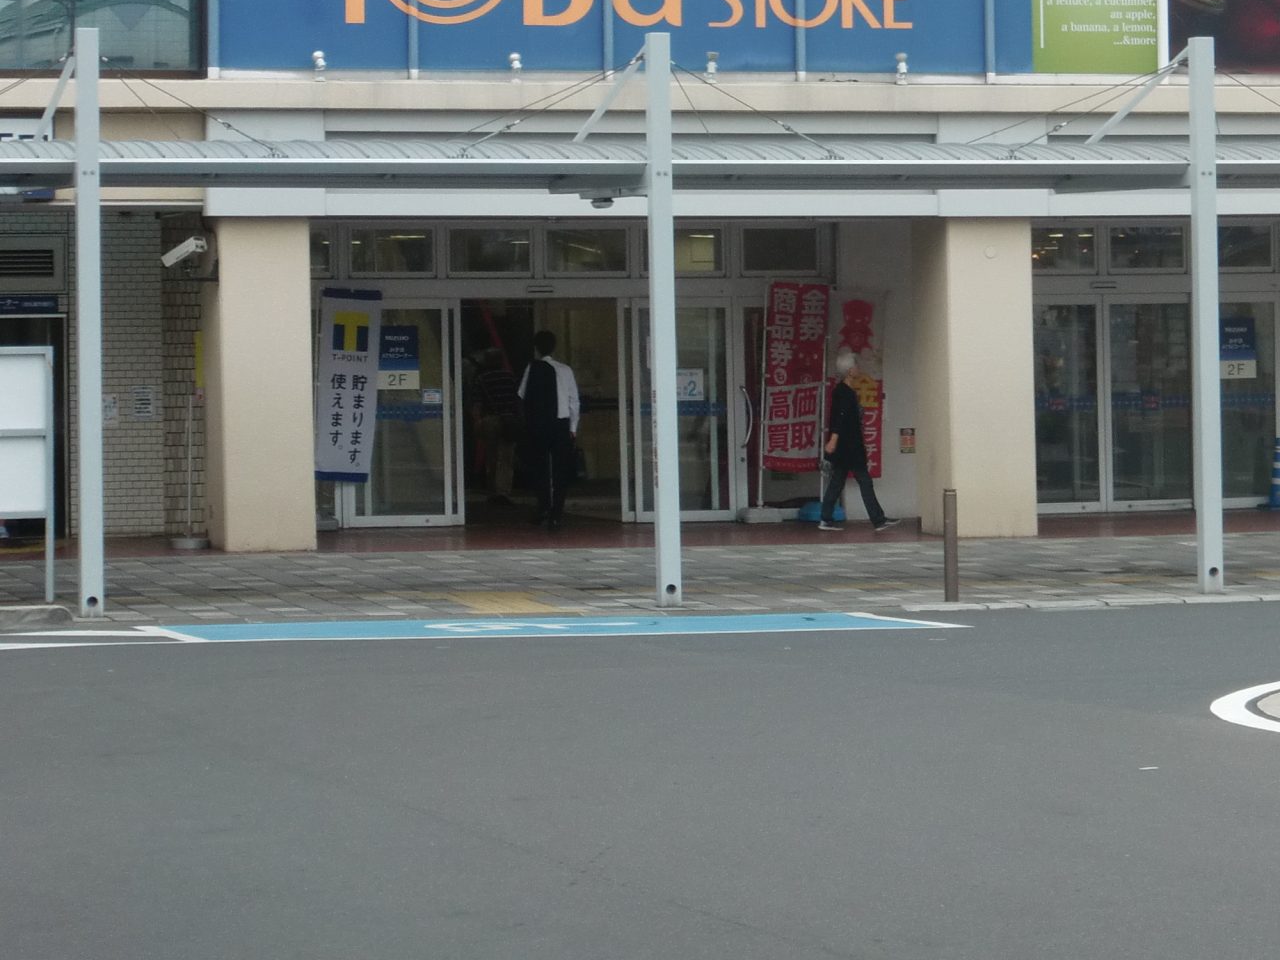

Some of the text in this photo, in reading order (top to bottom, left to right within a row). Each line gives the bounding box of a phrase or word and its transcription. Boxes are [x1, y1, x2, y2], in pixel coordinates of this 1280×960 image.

[388, 374, 408, 387] 2F
[1227, 363, 1245, 376] 2F
[329, 373, 347, 450] 使えます。
[348, 374, 368, 467] 貯まります。
